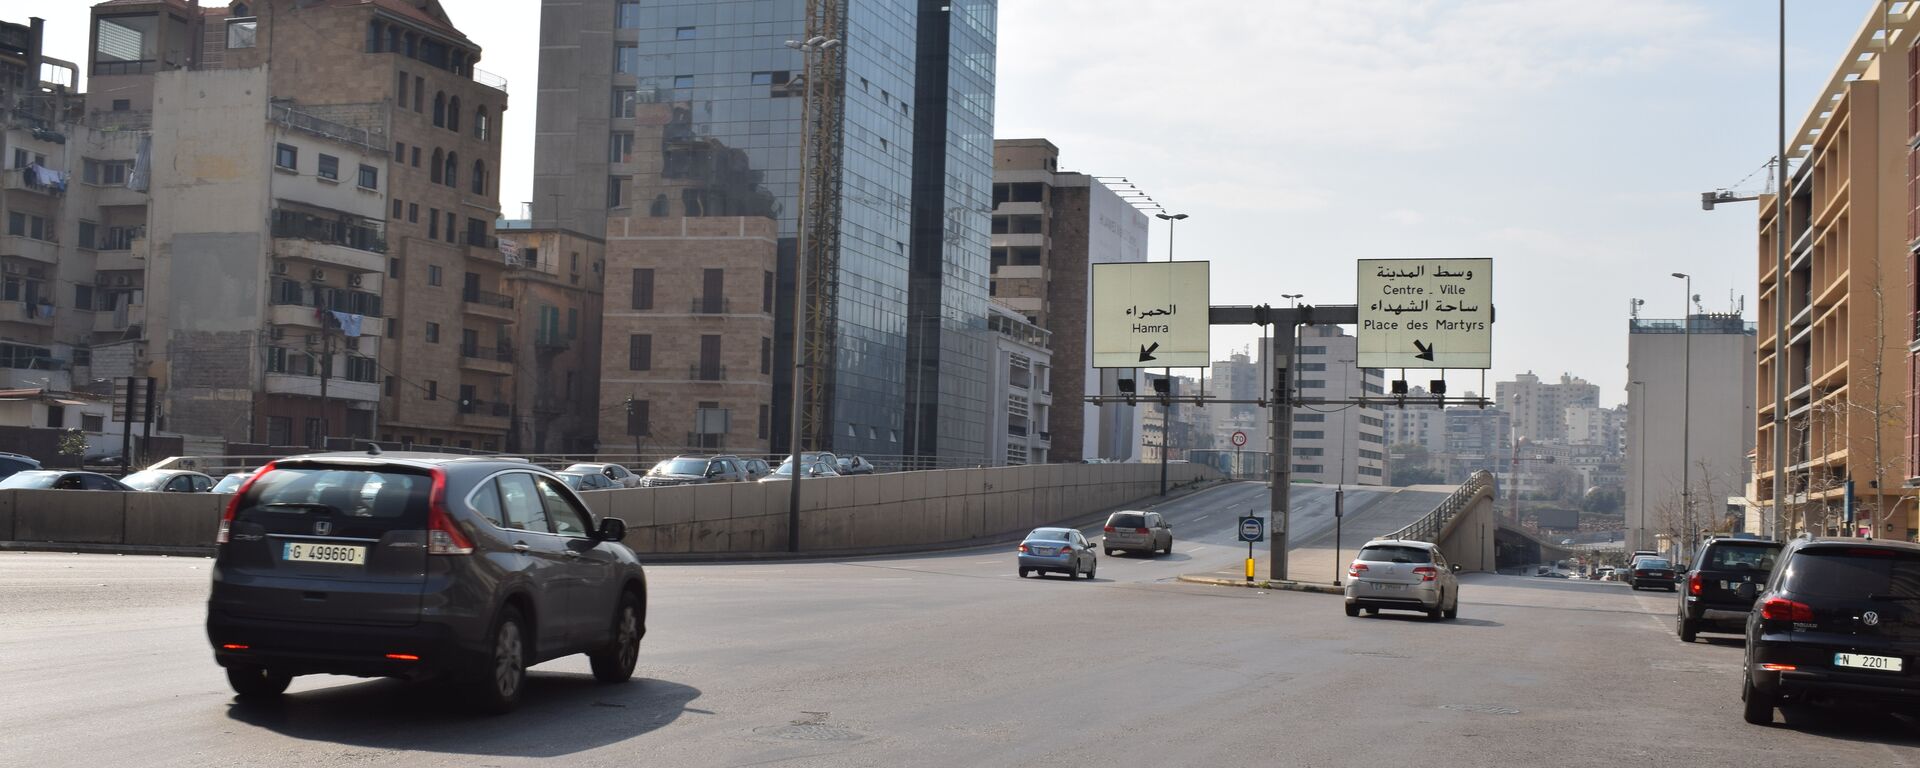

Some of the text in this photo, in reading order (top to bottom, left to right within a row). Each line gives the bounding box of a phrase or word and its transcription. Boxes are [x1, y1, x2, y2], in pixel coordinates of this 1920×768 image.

[1376, 264, 1473, 281] وسط المدينة
[1382, 284, 1424, 296] Centre
[1439, 284, 1466, 295] Ville
[1125, 303, 1177, 320] الحمراء
[1370, 299, 1479, 316] ساحة الشهداء
[1132, 323, 1169, 334] Hamra
[1364, 319, 1485, 333] Place des Martyrs
[293, 545, 355, 562] G 499660
[1842, 655, 1889, 669] N 2201
